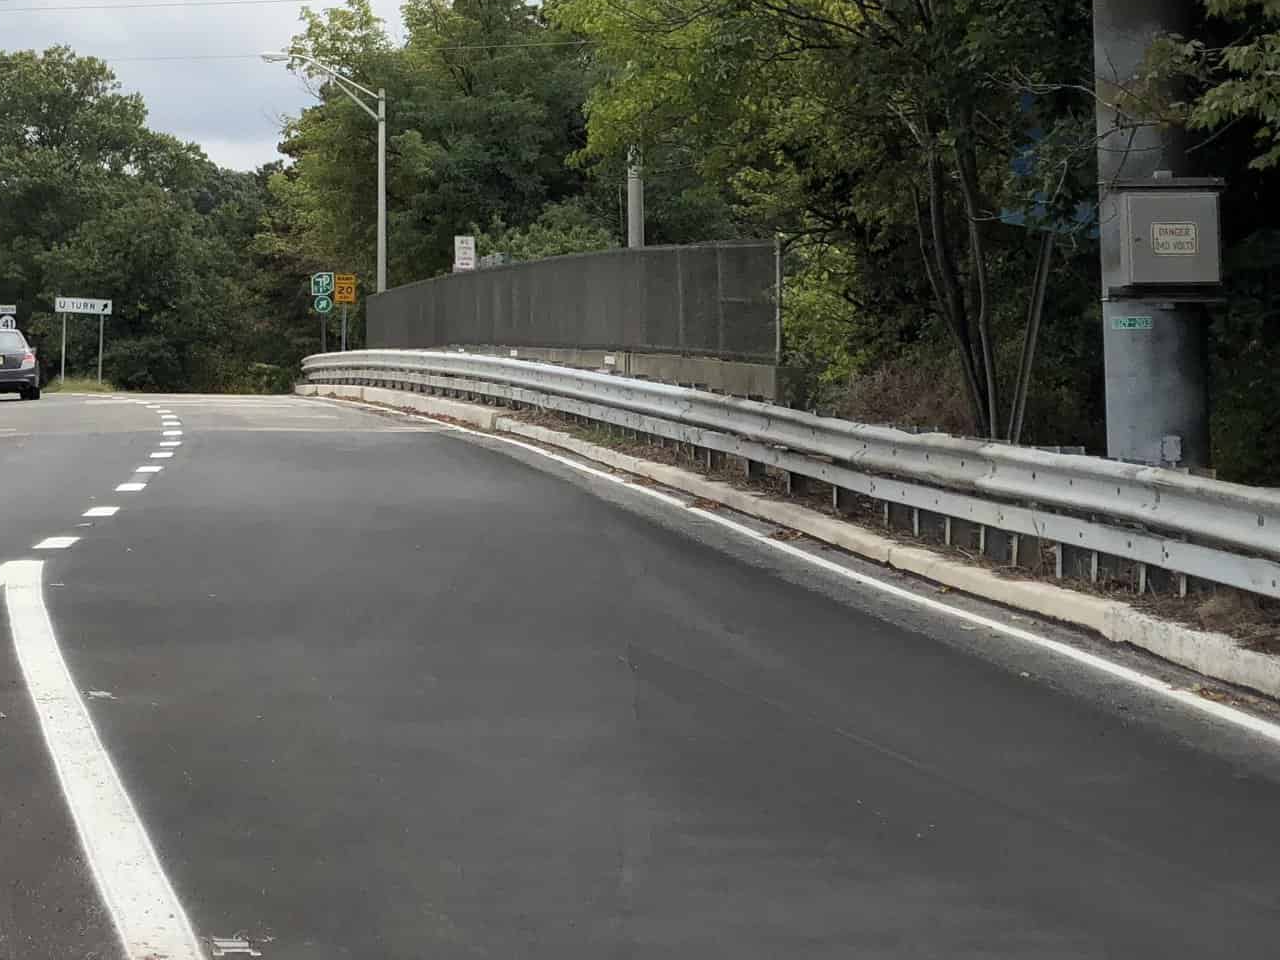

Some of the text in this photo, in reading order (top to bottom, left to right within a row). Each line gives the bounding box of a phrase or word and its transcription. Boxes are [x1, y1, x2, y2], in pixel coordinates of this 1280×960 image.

[1158, 227, 1192, 237] DANGER
[337, 286, 353, 295] 20
[59, 299, 96, 311] U TURN
[2, 319, 14, 329] 41
